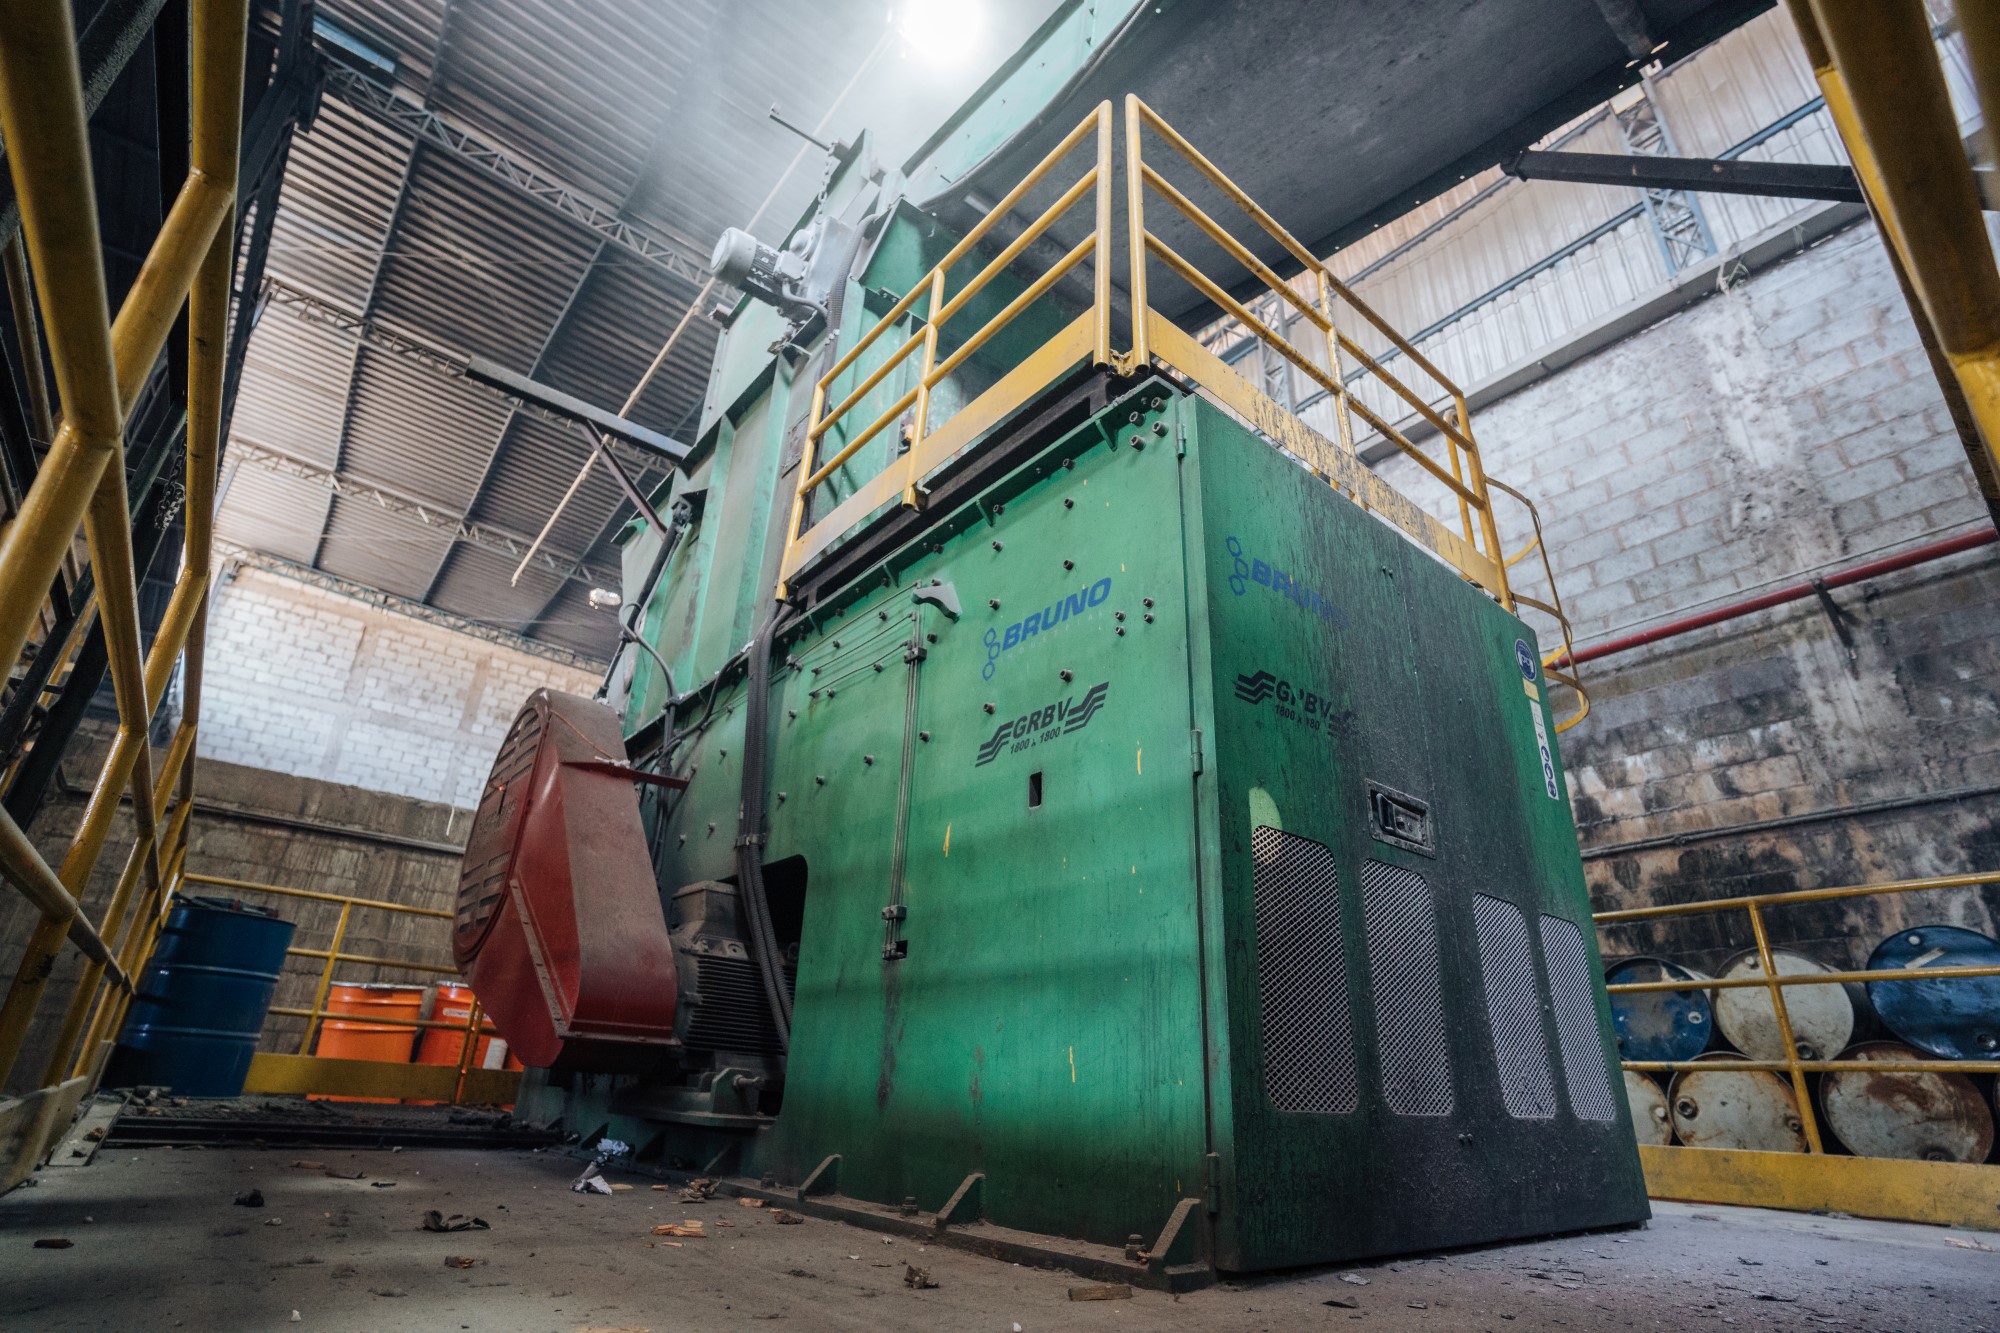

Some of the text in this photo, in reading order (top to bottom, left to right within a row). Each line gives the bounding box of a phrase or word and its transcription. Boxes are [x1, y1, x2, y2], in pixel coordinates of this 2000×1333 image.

[1002, 577, 1112, 652] BRUNO
[1013, 696, 1073, 739] GRBV
[1275, 703, 1295, 721] 1800
[1010, 738, 1030, 754] 1800
[1040, 726, 1061, 744] 1800
